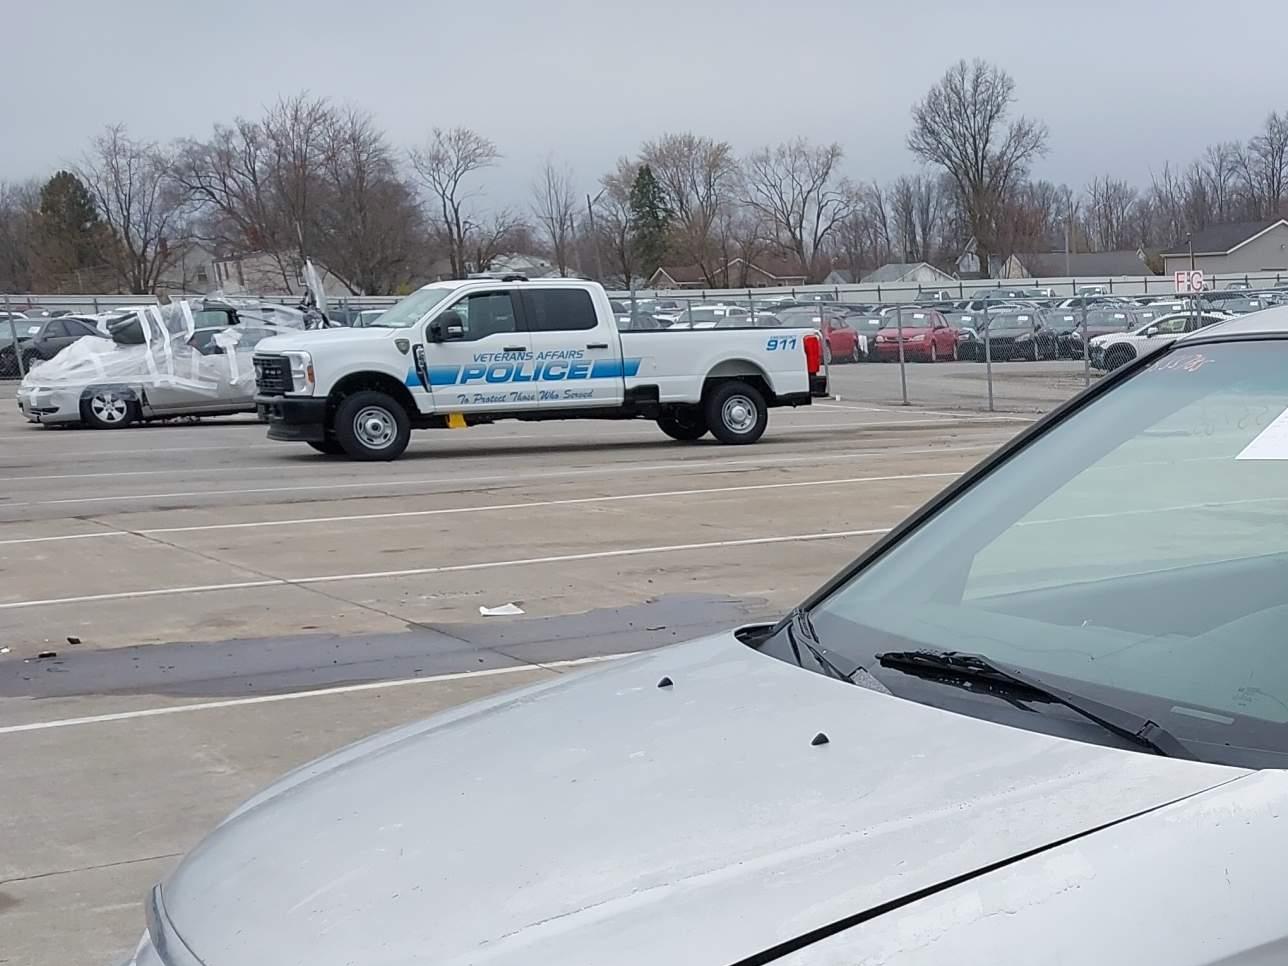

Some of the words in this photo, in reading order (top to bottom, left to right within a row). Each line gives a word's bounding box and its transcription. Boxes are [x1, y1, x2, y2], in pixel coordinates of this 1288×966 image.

[766, 338, 797, 351] 911
[473, 351, 533, 362] VETERANS
[536, 350, 585, 360] AFFAIRS
[460, 360, 592, 385] POLICE
[457, 394, 469, 404] To
[473, 393, 506, 404] Protect
[510, 391, 536, 401] Those
[539, 390, 559, 400] Who
[563, 389, 594, 399] Served
